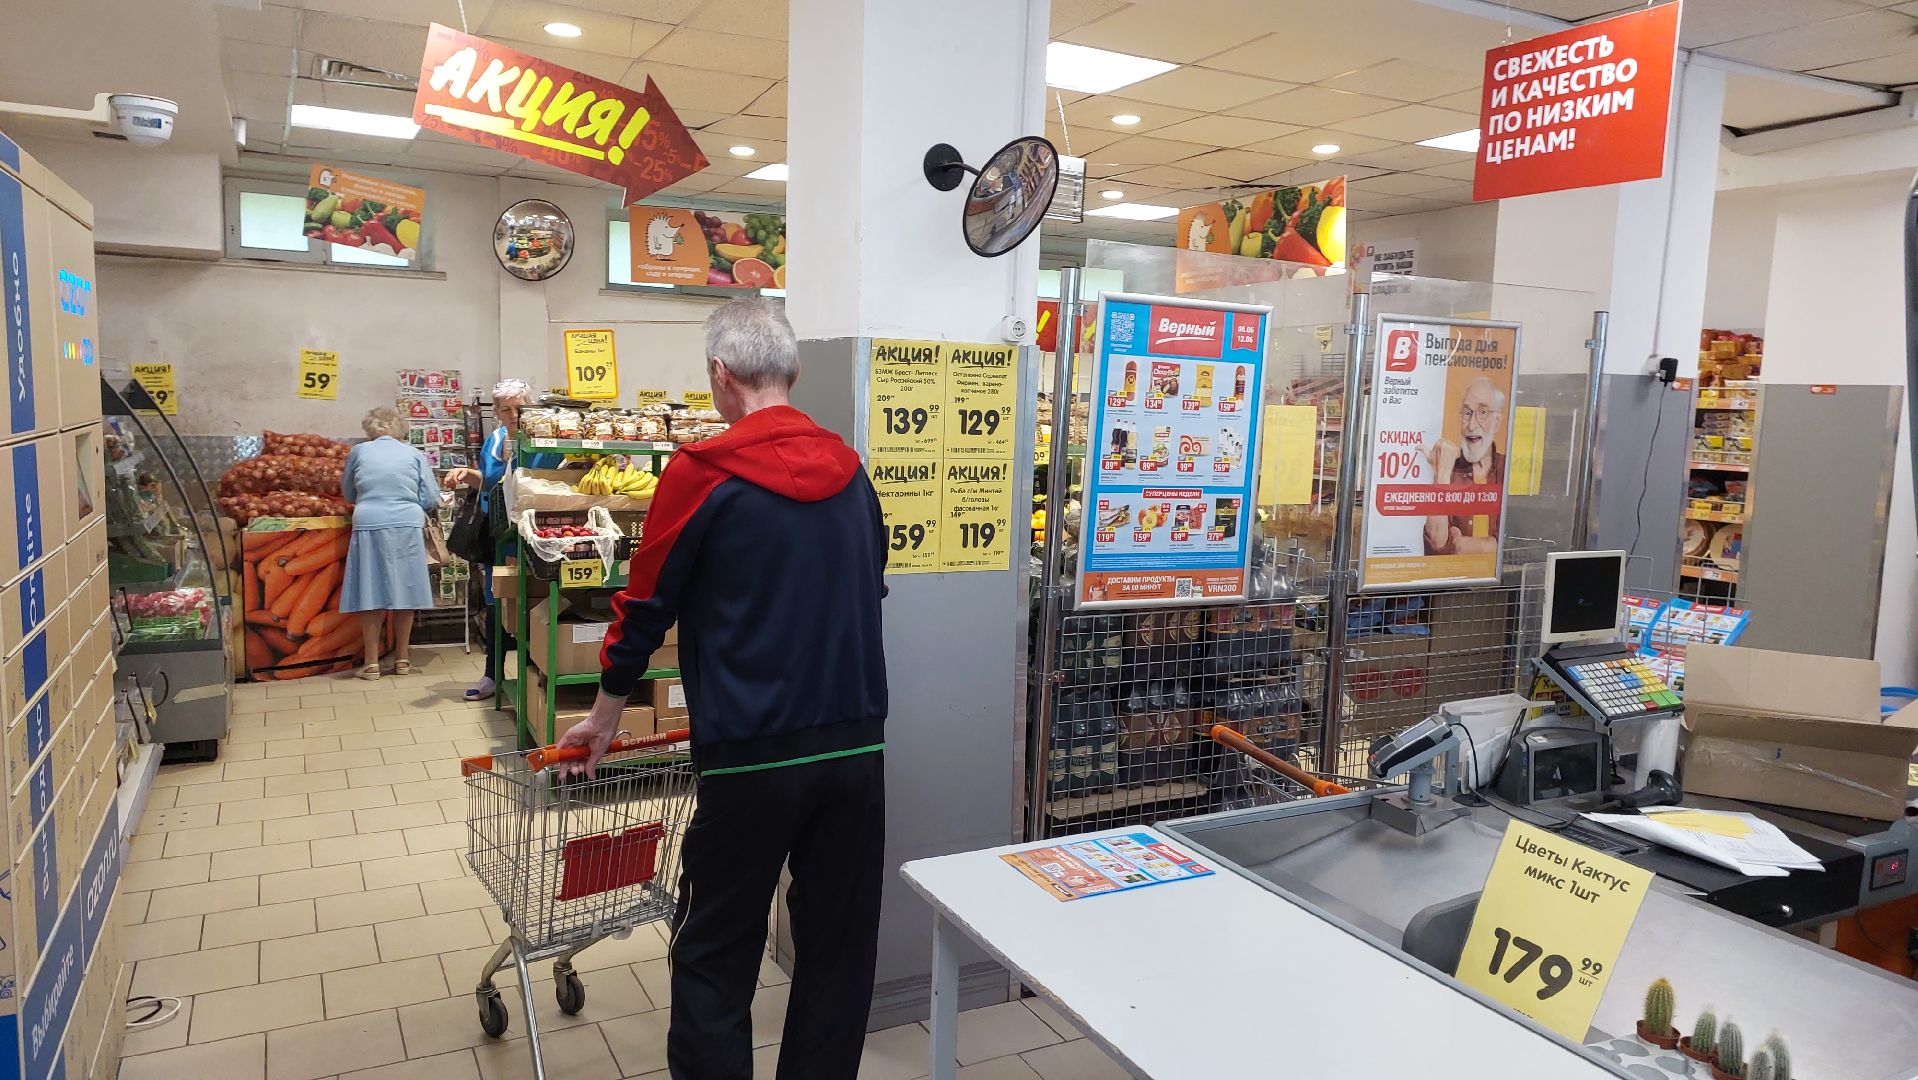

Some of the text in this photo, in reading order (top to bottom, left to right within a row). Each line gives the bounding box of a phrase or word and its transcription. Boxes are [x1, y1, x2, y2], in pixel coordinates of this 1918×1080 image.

[1493, 34, 1614, 81] СВЕЖЕСТЬ
[1491, 58, 1638, 109] И КАЧЕСТВО
[429, 47, 650, 165] АКЦИЯ!
[1488, 88, 1635, 136] ПО НИЗКИМ
[1486, 128, 1576, 165] ЦЕНАМ!
[1158, 317, 1216, 337] Верный
[1425, 333, 1498, 354] Выгода для
[875, 345, 941, 366] АКЦИЯ!
[951, 349, 1013, 369] АКЦИЯ!
[1424, 353, 1507, 371] пенсионеров!
[304, 372, 330, 389] 59
[575, 365, 606, 381] 109
[876, 376, 889, 384] Сыр
[1384, 376, 1411, 386] Верный
[639, 390, 668, 399] АКЦИЯ!
[684, 392, 711, 400] АКЦИЯ!
[1383, 386, 1418, 396] заботится
[1390, 396, 1402, 405] Вас
[882, 404, 940, 435] 139 99
[958, 406, 1011, 436] 129 99
[1380, 430, 1423, 446] СКИДКА
[873, 462, 936, 483] АКЦИЯ!
[947, 462, 1008, 483] АКЦИЯ!
[1378, 451, 1420, 479] 10%
[876, 489, 934, 498] Нектарины 1кг
[1384, 491, 1437, 505] ЕЖЕДНЕВНО
[1438, 492, 1444, 502] С
[1463, 491, 1476, 504] ДО
[1477, 491, 1498, 503] 13:00
[884, 519, 937, 551] 159 99
[959, 518, 1007, 549] 119 99
[568, 567, 593, 581] 159
[1107, 575, 1176, 585] ДОСТАВИМ ПРОДУКТЫ
[1208, 584, 1237, 592] VRN200
[1515, 834, 1631, 892] Цветы Кактус
[1524, 865, 1601, 904] микс 1шт
[1488, 927, 1603, 1000] 179 99
[1578, 976, 1593, 988] шт
[32, 944, 75, 1061] Выбирайте
